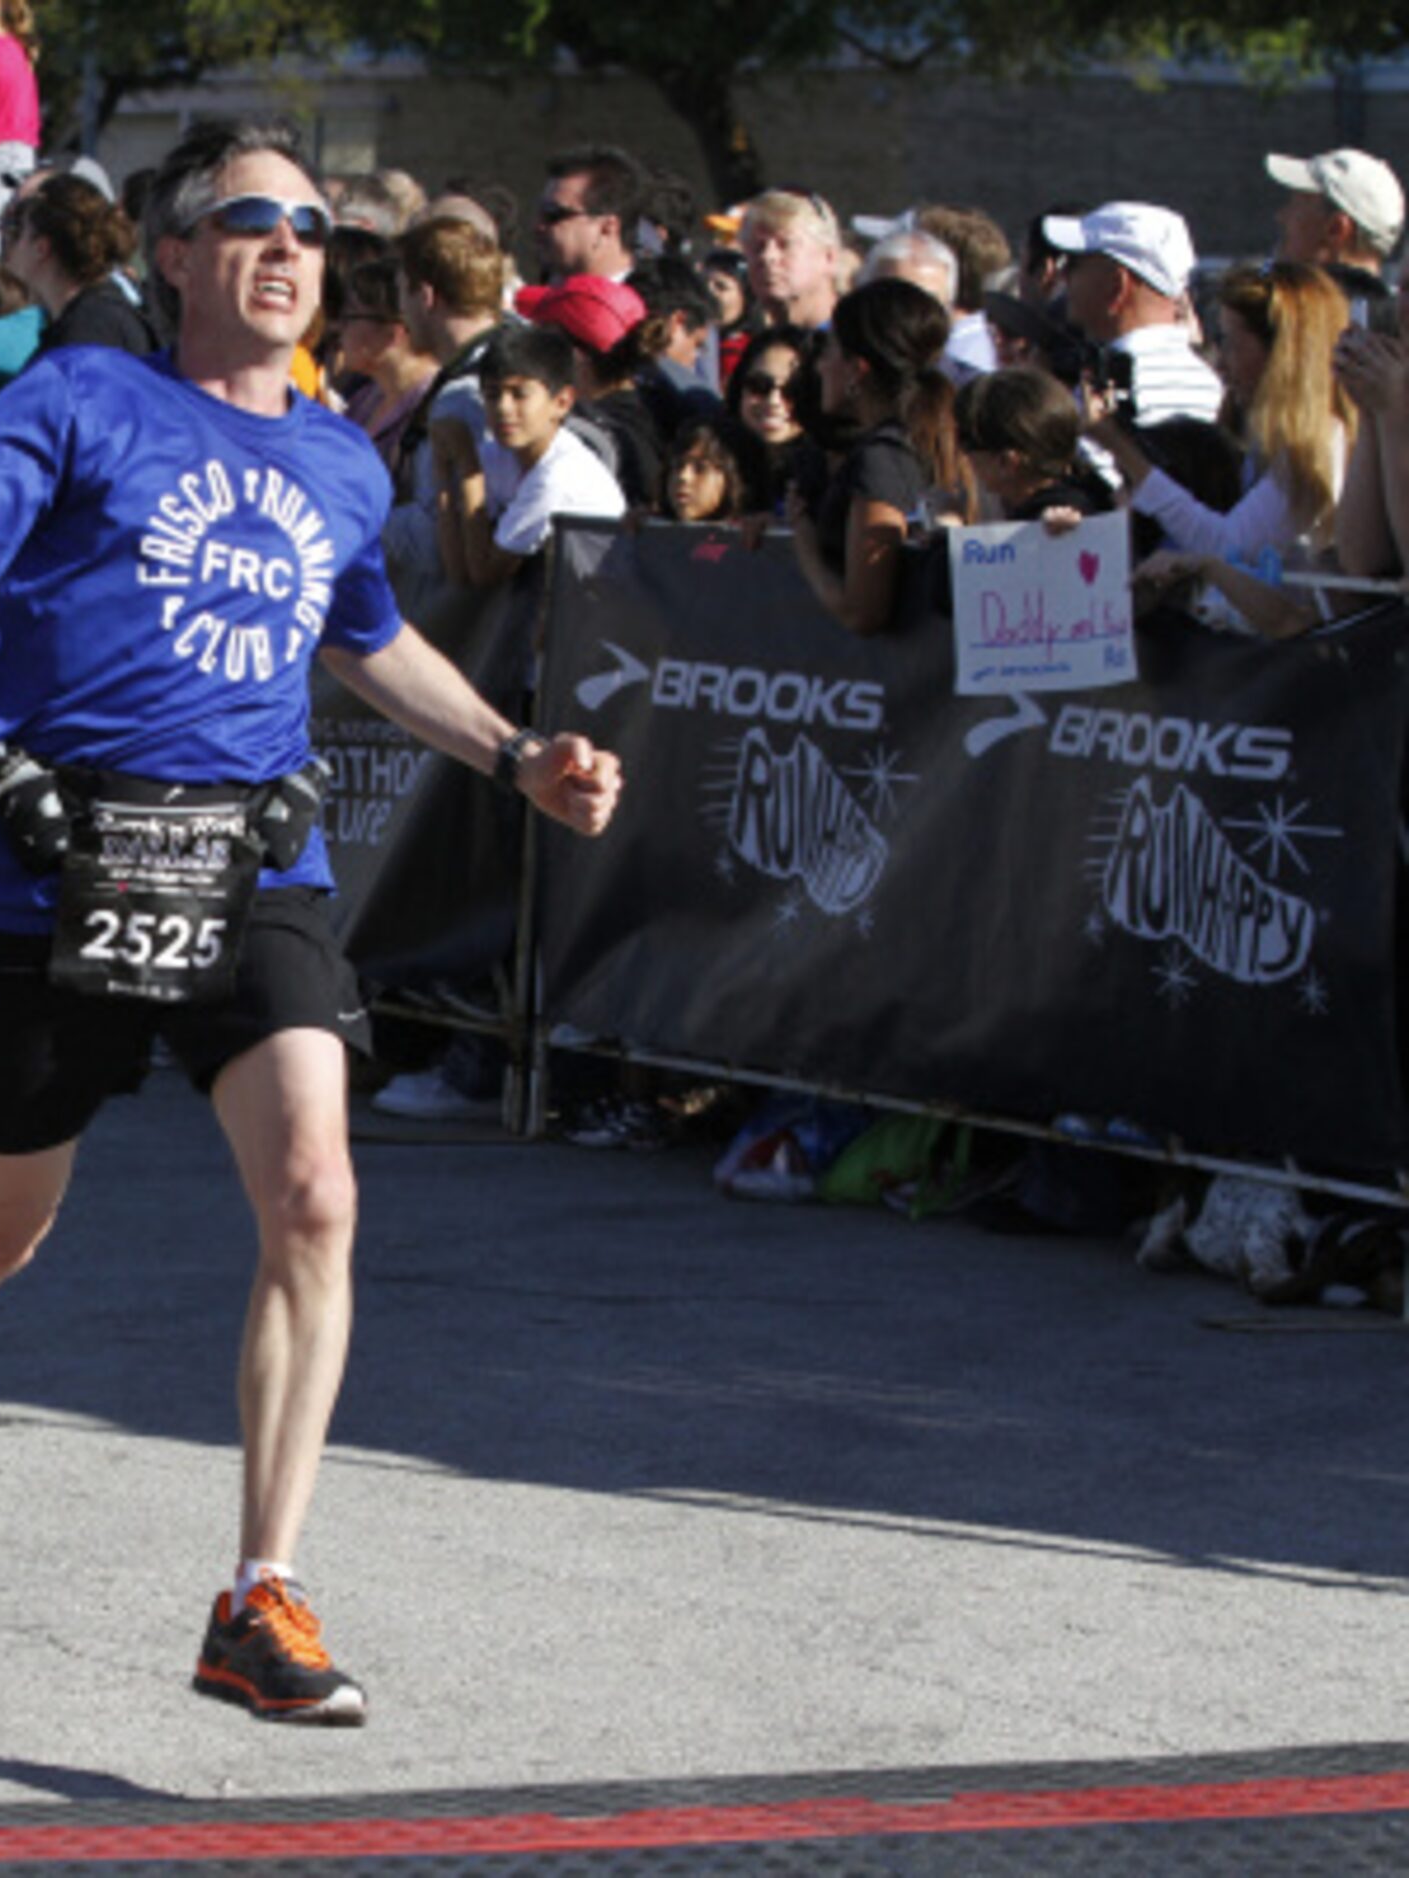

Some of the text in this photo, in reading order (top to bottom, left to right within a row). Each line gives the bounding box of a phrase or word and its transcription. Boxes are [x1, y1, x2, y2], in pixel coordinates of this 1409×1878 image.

[137, 460, 335, 637] FRISCO RUNNING
[201, 539, 293, 600] FRC
[963, 540, 1016, 564] Run
[173, 611, 274, 682] CLUB
[653, 659, 883, 730] BROOKS
[1050, 706, 1291, 780] BROOKS
[79, 909, 228, 969] 2525
